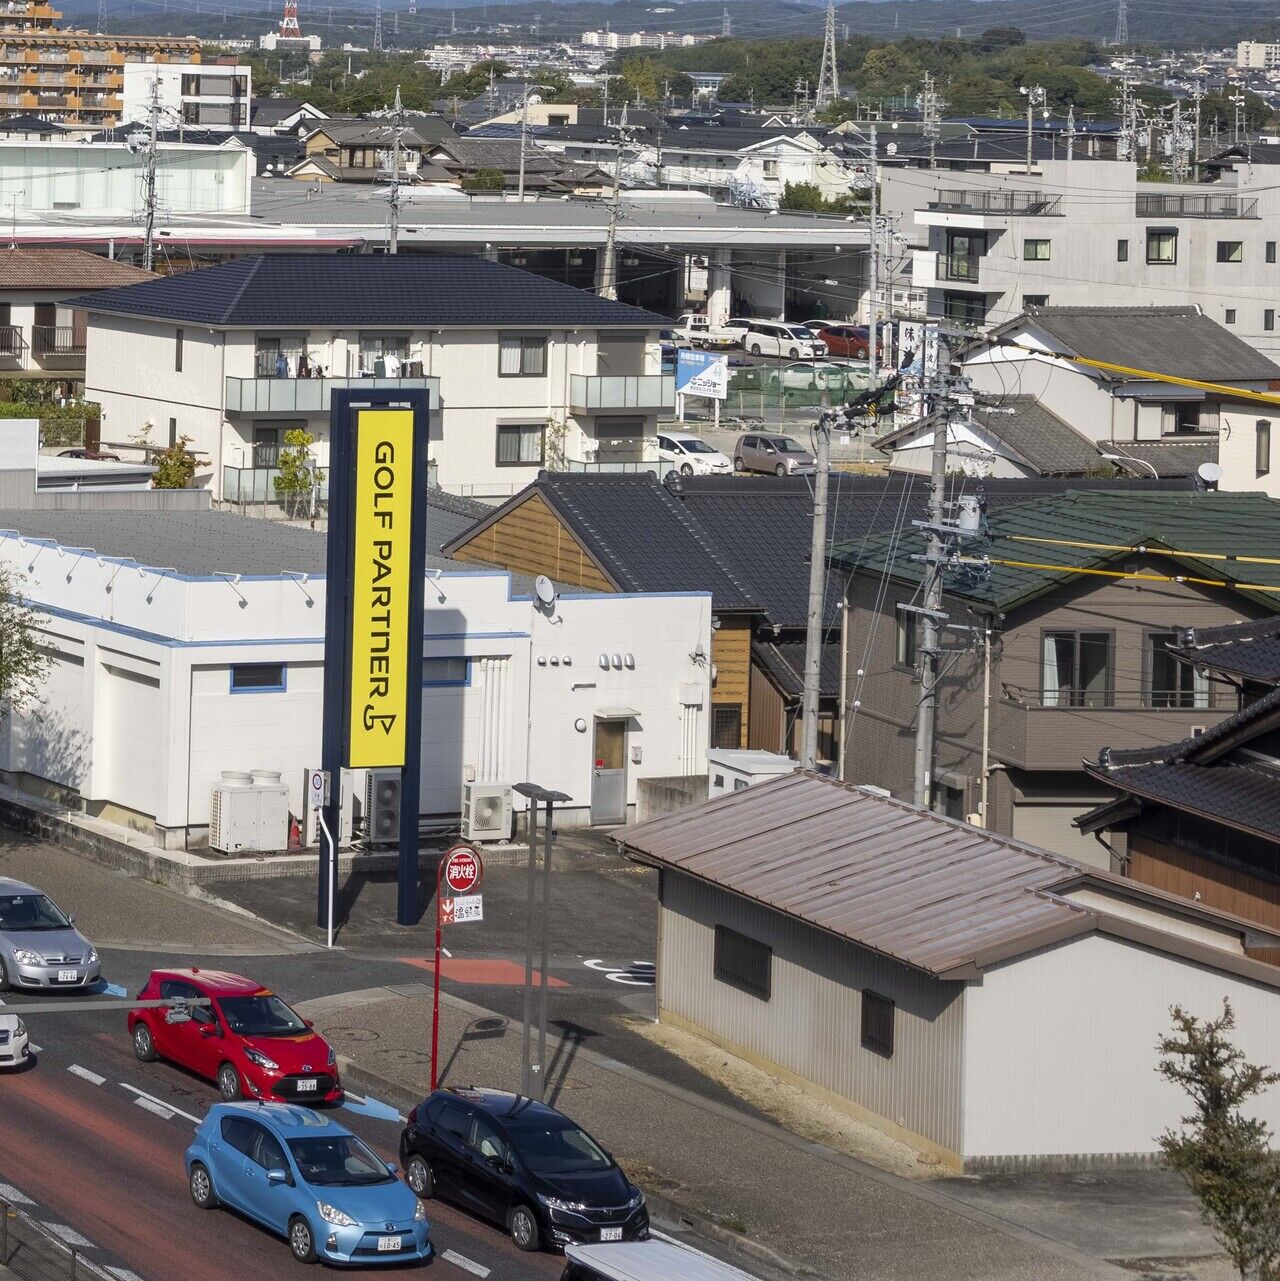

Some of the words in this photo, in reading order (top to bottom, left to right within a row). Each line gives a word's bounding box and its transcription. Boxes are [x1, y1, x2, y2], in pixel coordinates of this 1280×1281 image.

[373, 440, 395, 530] GOLF
[369, 540, 393, 698] PARTNER
[449, 864, 475, 880] 消火栓
